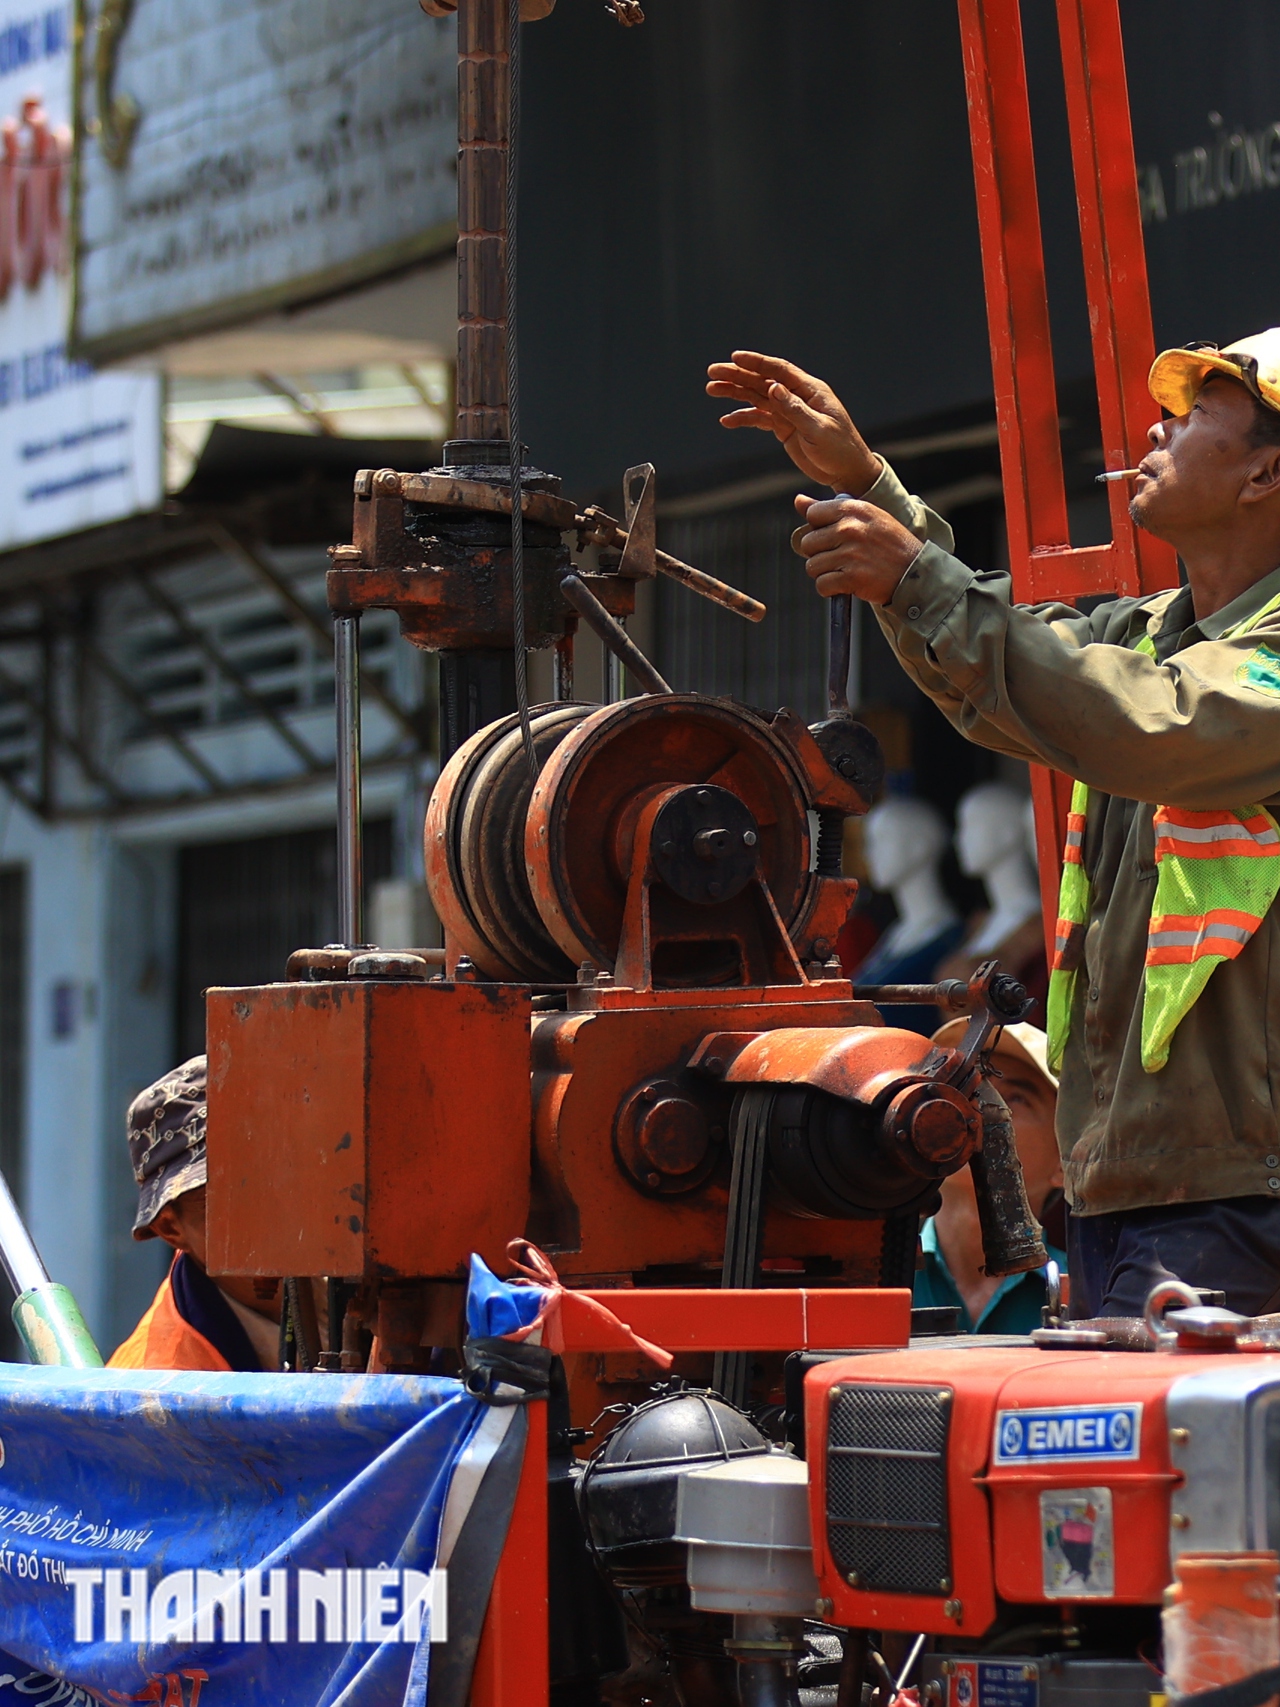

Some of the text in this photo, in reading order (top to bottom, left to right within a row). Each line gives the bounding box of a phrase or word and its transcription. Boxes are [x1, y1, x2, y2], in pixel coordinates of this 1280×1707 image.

[1027, 1417, 1106, 1450] EMEI
[2, 1505, 58, 1535] PHỐ
[41, 1510, 83, 1541] HỒ
[100, 1527, 153, 1552] MINH
[17, 1549, 39, 1580] ĐÔ
[42, 1557, 69, 1591] THỊ
